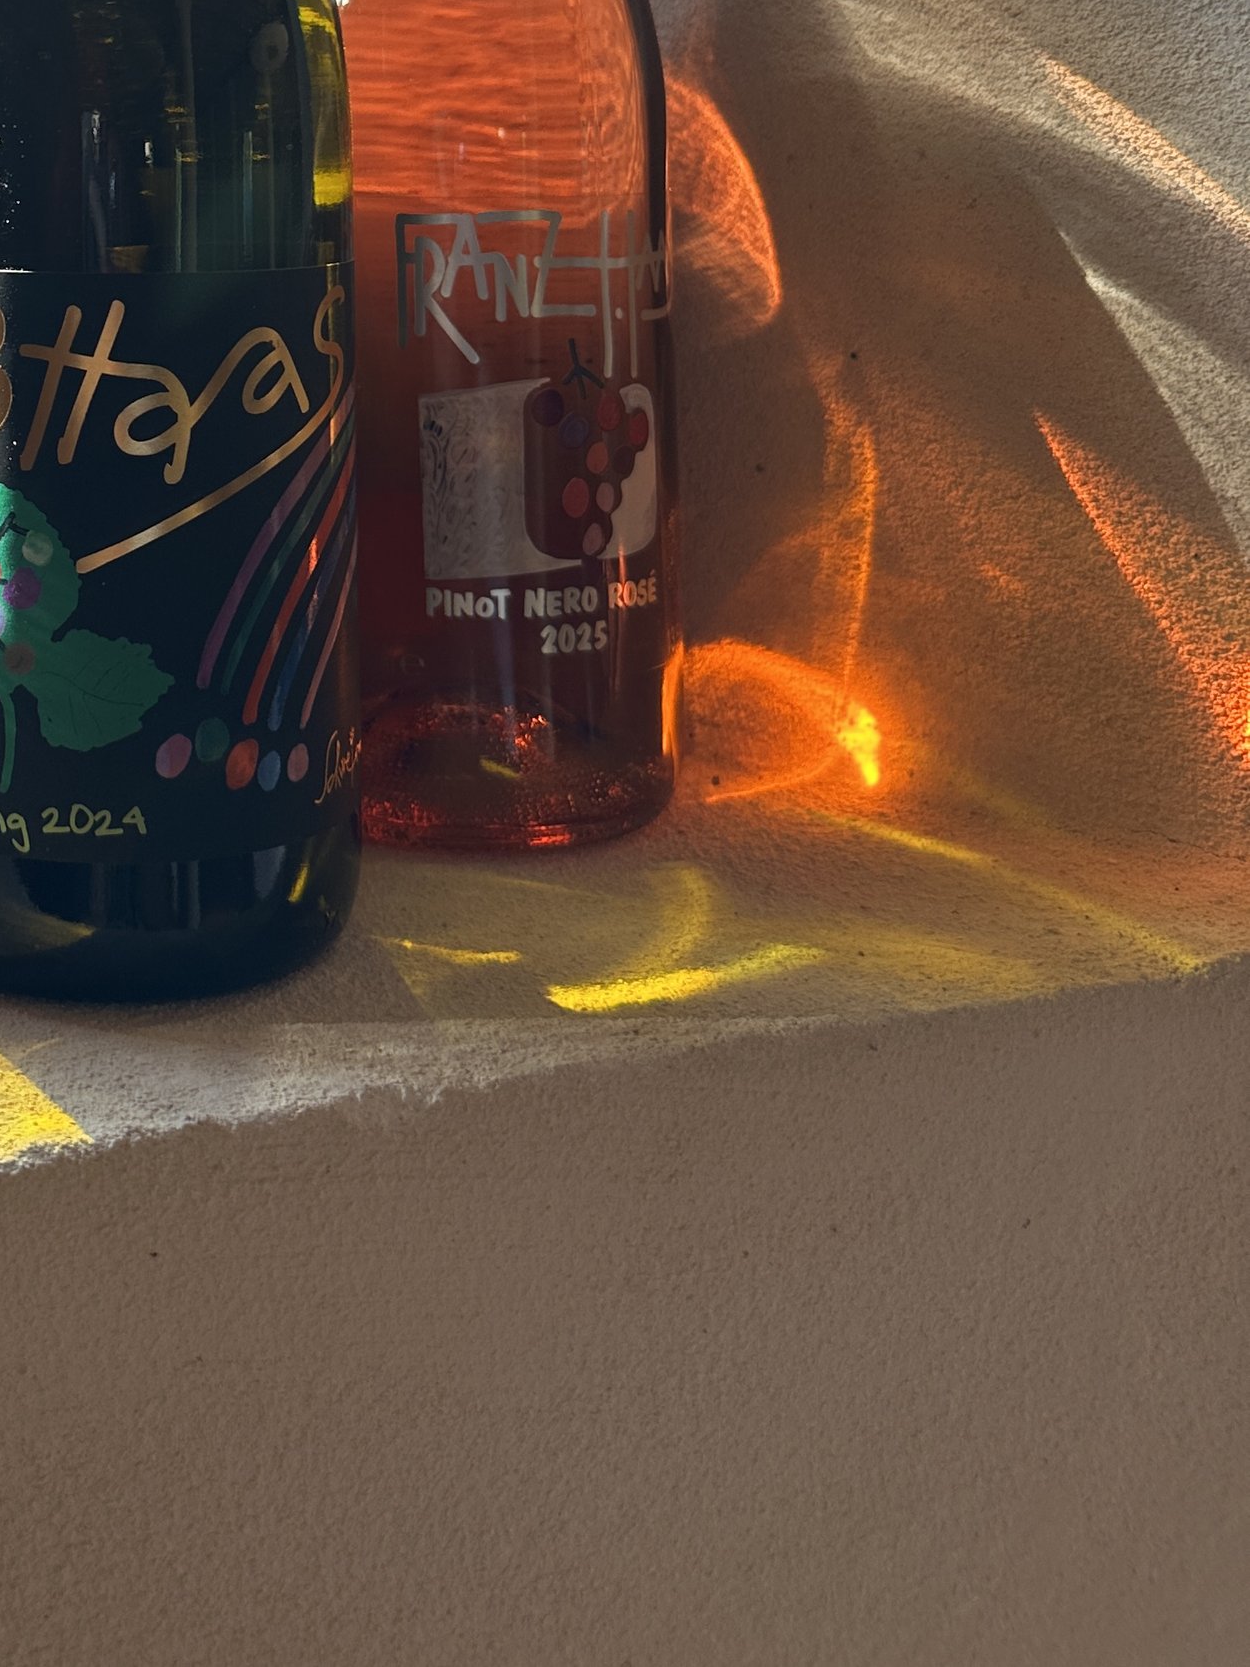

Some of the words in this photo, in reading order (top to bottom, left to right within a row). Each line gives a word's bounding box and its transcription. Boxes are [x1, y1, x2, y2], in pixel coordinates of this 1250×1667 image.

[523, 585, 599, 619] NERO
[540, 619, 608, 655] 2025
[41, 802, 148, 836] 2024
